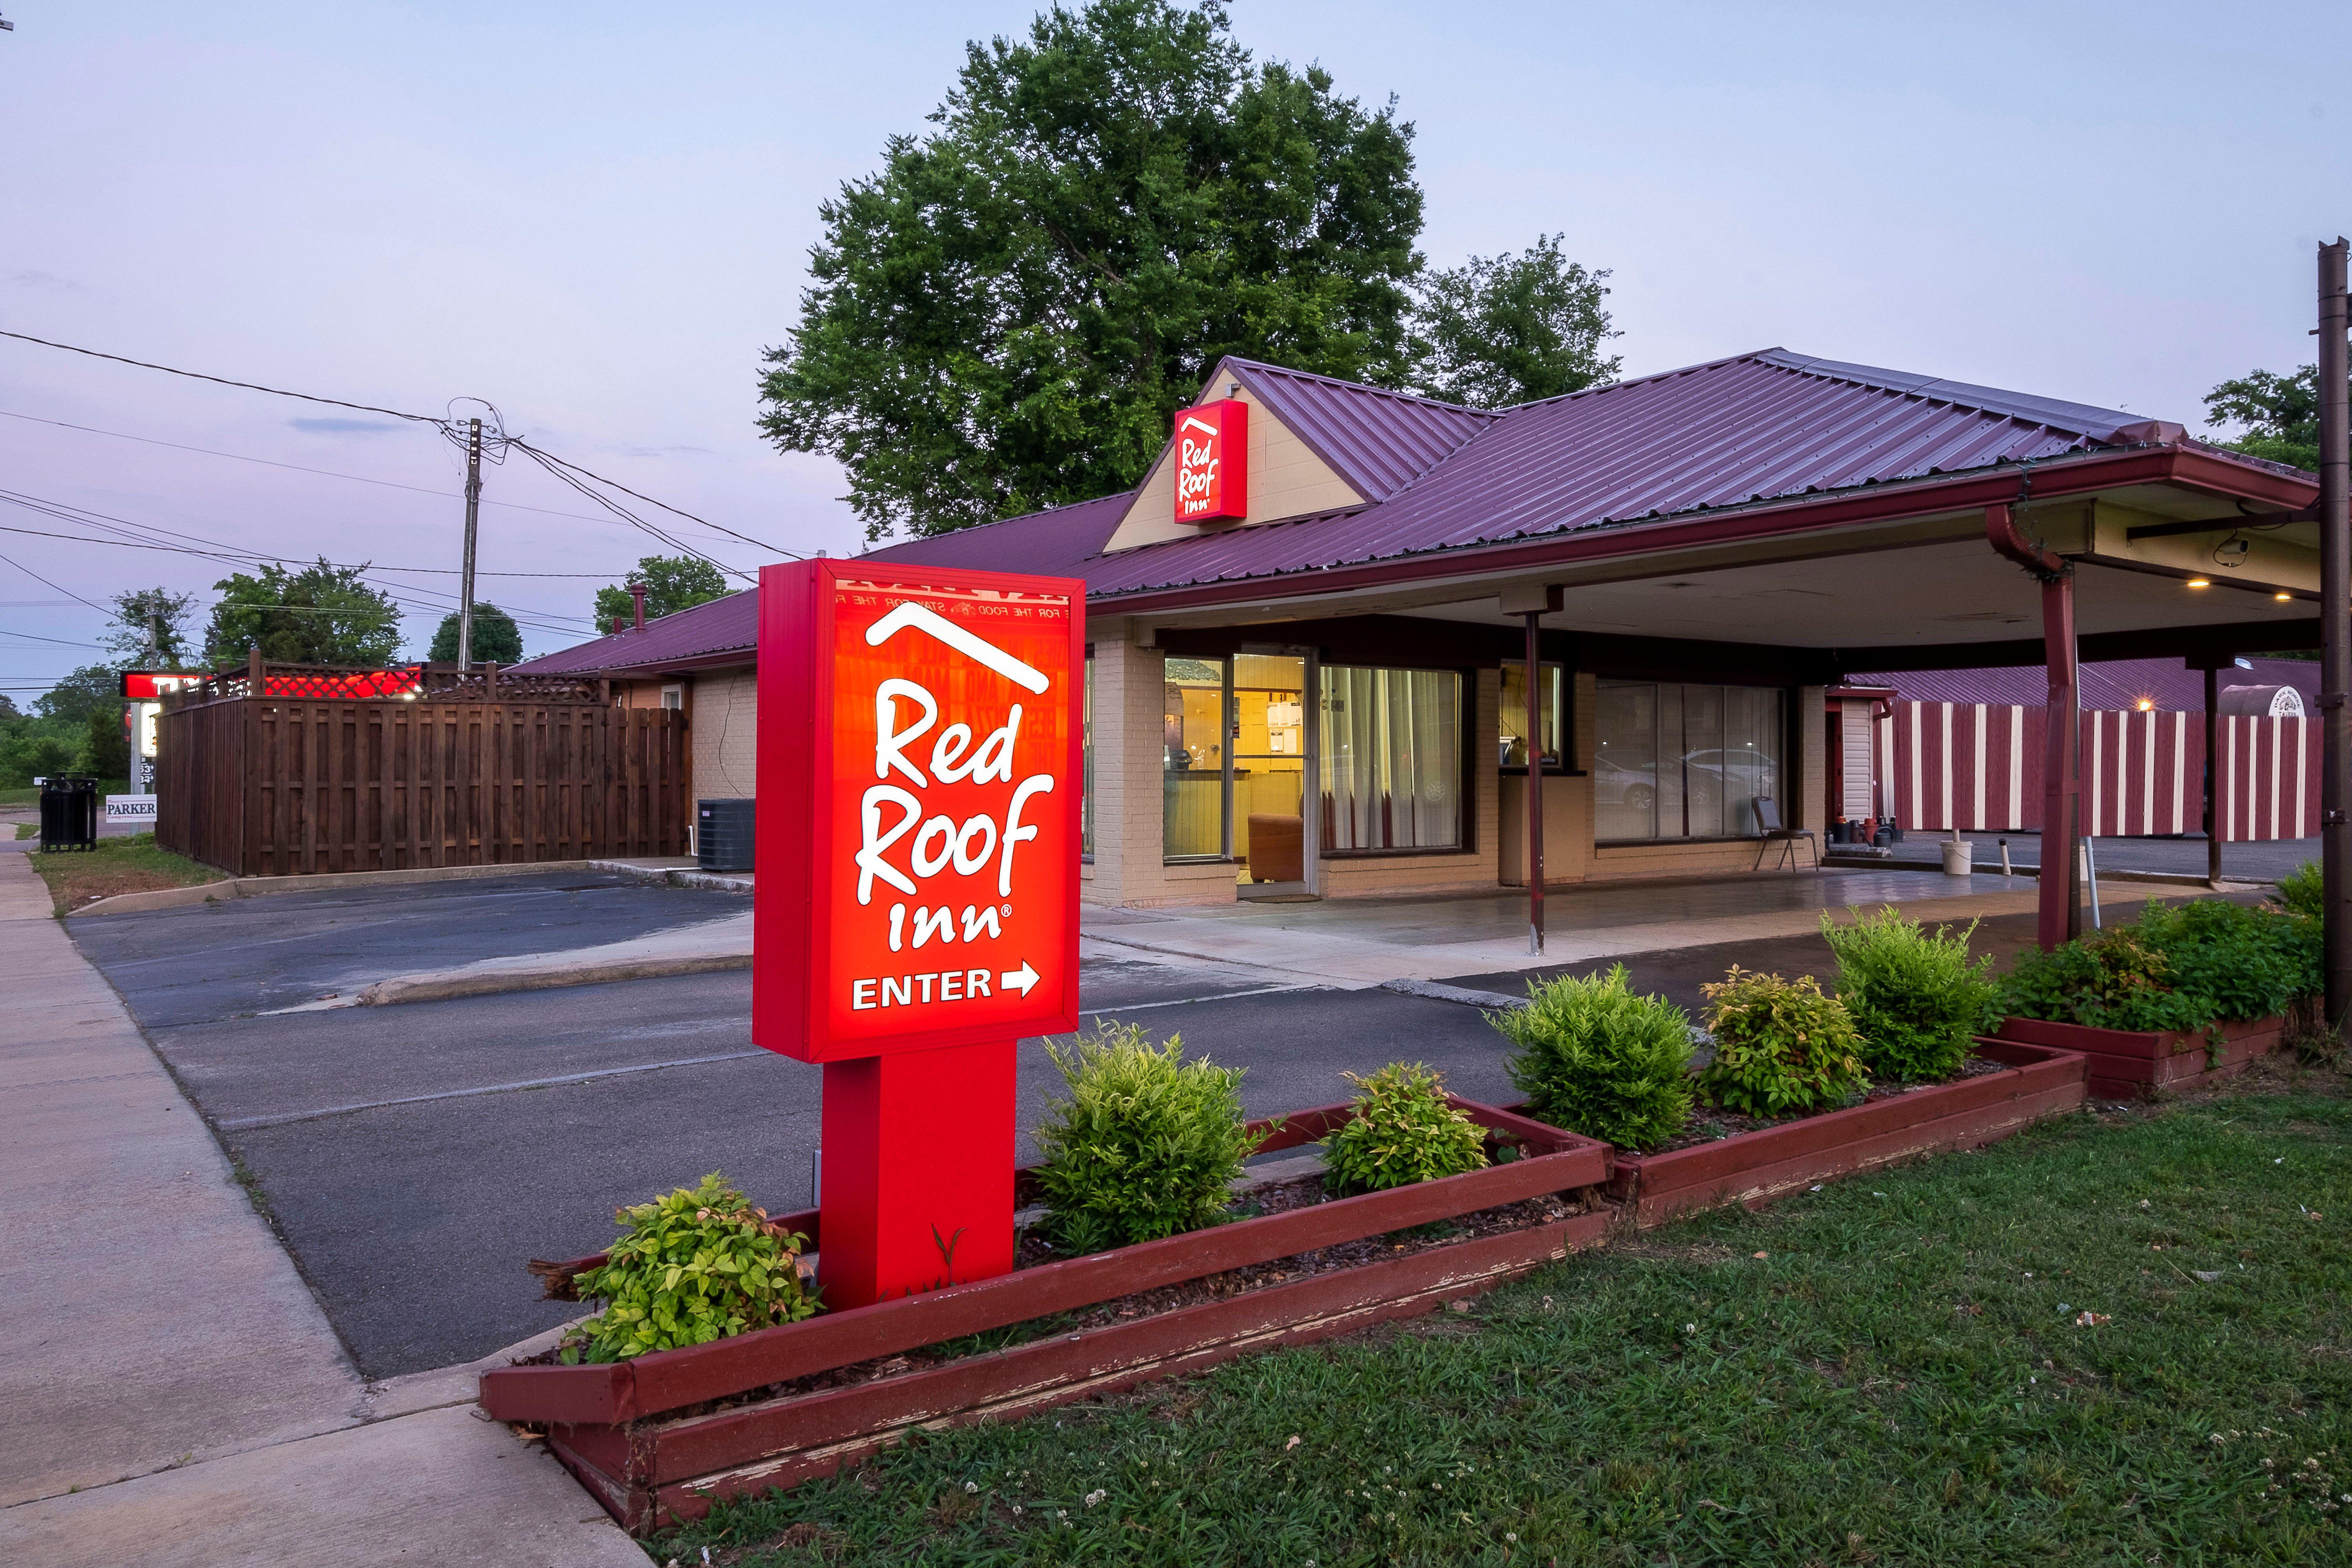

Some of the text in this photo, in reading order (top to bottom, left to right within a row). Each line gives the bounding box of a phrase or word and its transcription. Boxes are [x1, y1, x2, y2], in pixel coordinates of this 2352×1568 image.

[1182, 438, 1212, 469] Red
[1179, 458, 1219, 502] Roof
[876, 678, 1023, 789] Red
[107, 803, 156, 814] PARKER
[855, 774, 1054, 905] Roof
[853, 969, 992, 1010] ENTER
